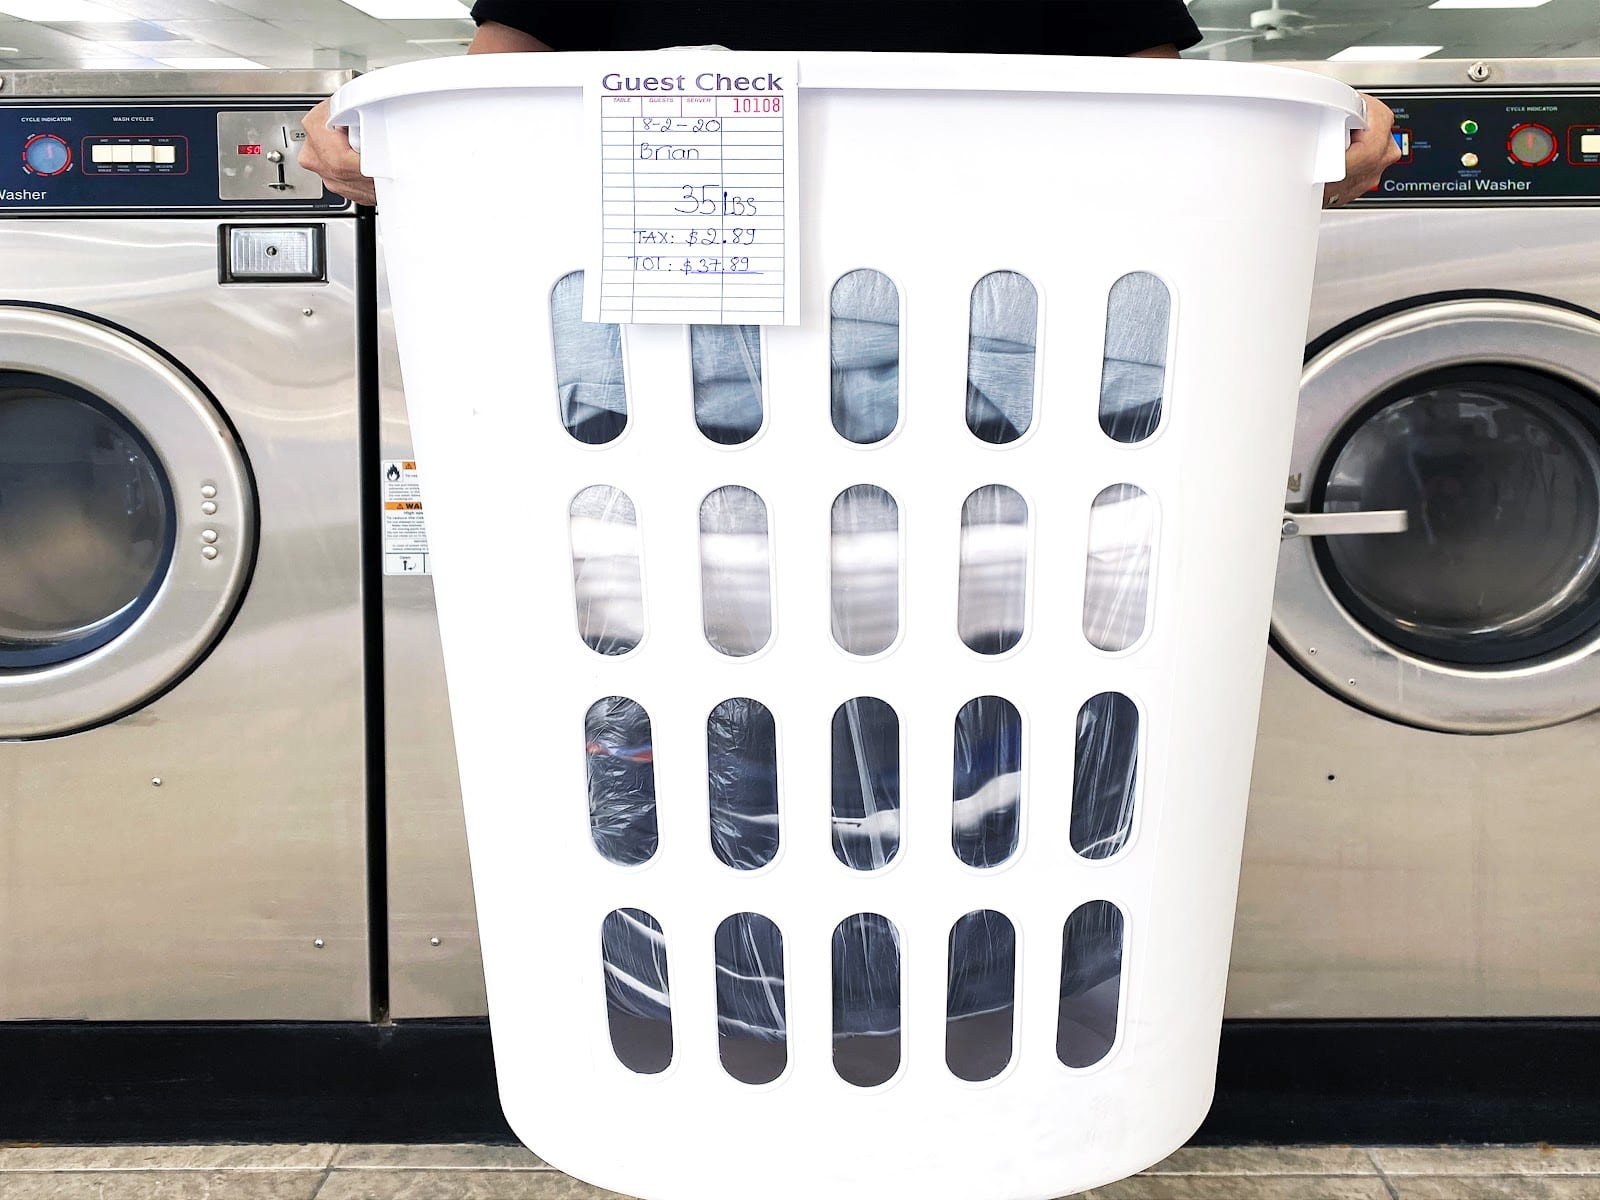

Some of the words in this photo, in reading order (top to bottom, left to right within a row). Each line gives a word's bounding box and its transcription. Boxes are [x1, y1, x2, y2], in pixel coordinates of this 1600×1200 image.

[602, 73, 685, 91] Guest
[695, 73, 784, 91] Check
[733, 97, 781, 113] 10108
[640, 142, 700, 160] Brian
[1384, 179, 1472, 191] Commercial
[1475, 179, 1531, 190] Washer
